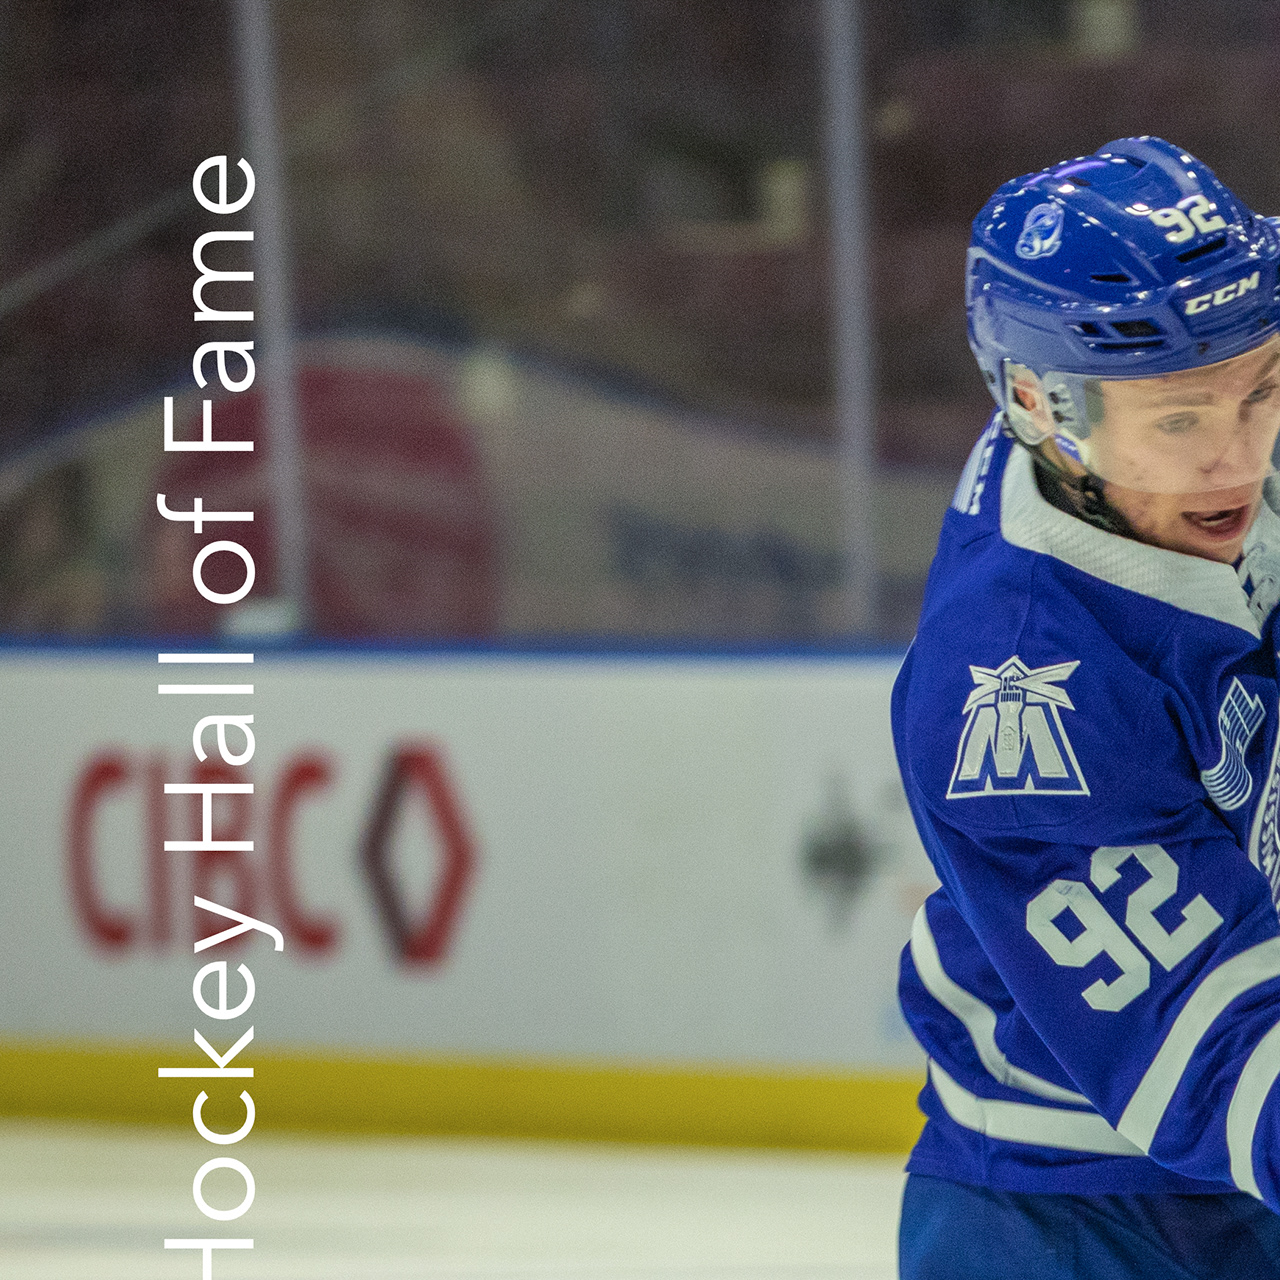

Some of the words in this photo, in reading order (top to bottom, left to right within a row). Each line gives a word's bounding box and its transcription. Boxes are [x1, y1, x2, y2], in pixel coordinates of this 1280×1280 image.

[1150, 195, 1227, 244] 92
[1184, 271, 1261, 317] CCM
[62, 742, 345, 963] CIBC
[1025, 843, 1225, 1013] 92
